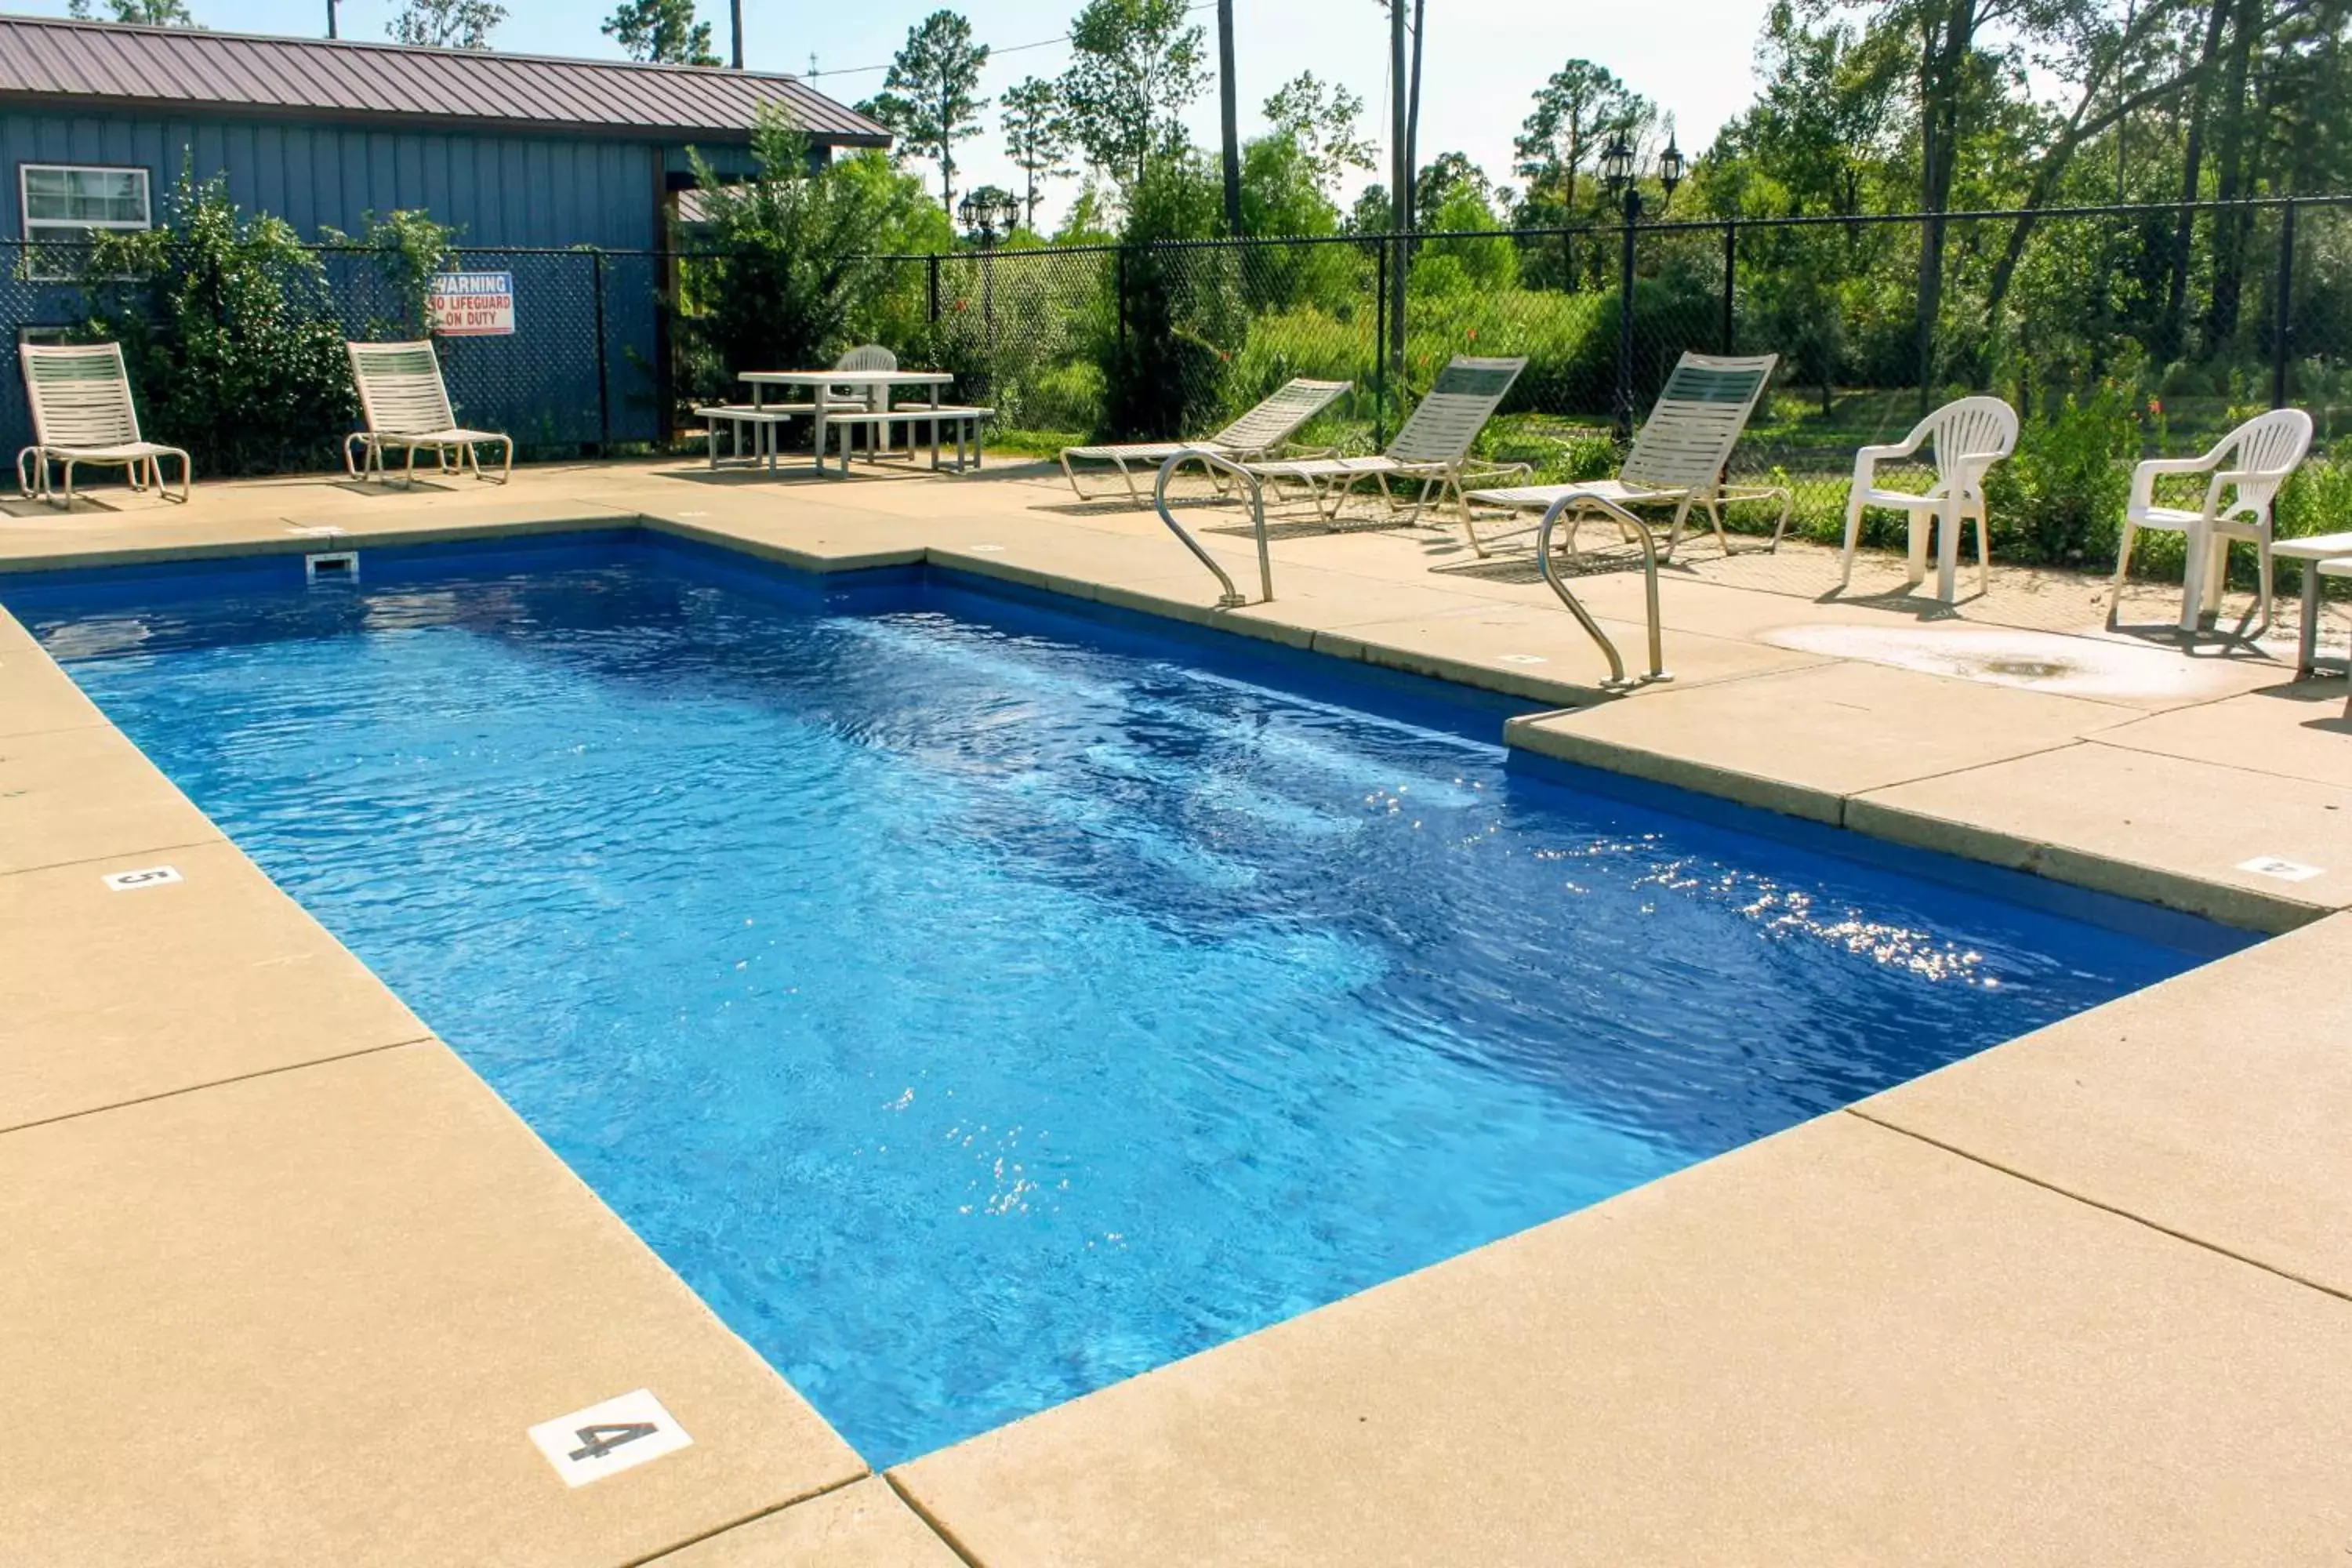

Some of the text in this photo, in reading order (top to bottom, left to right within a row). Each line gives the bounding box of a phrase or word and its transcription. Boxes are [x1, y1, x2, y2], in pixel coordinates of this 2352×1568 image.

[451, 296, 510, 310] LIFEGUARD
[446, 311, 496, 326] ON DUTY
[117, 871, 169, 884] 5
[568, 1422, 659, 1462] 4
